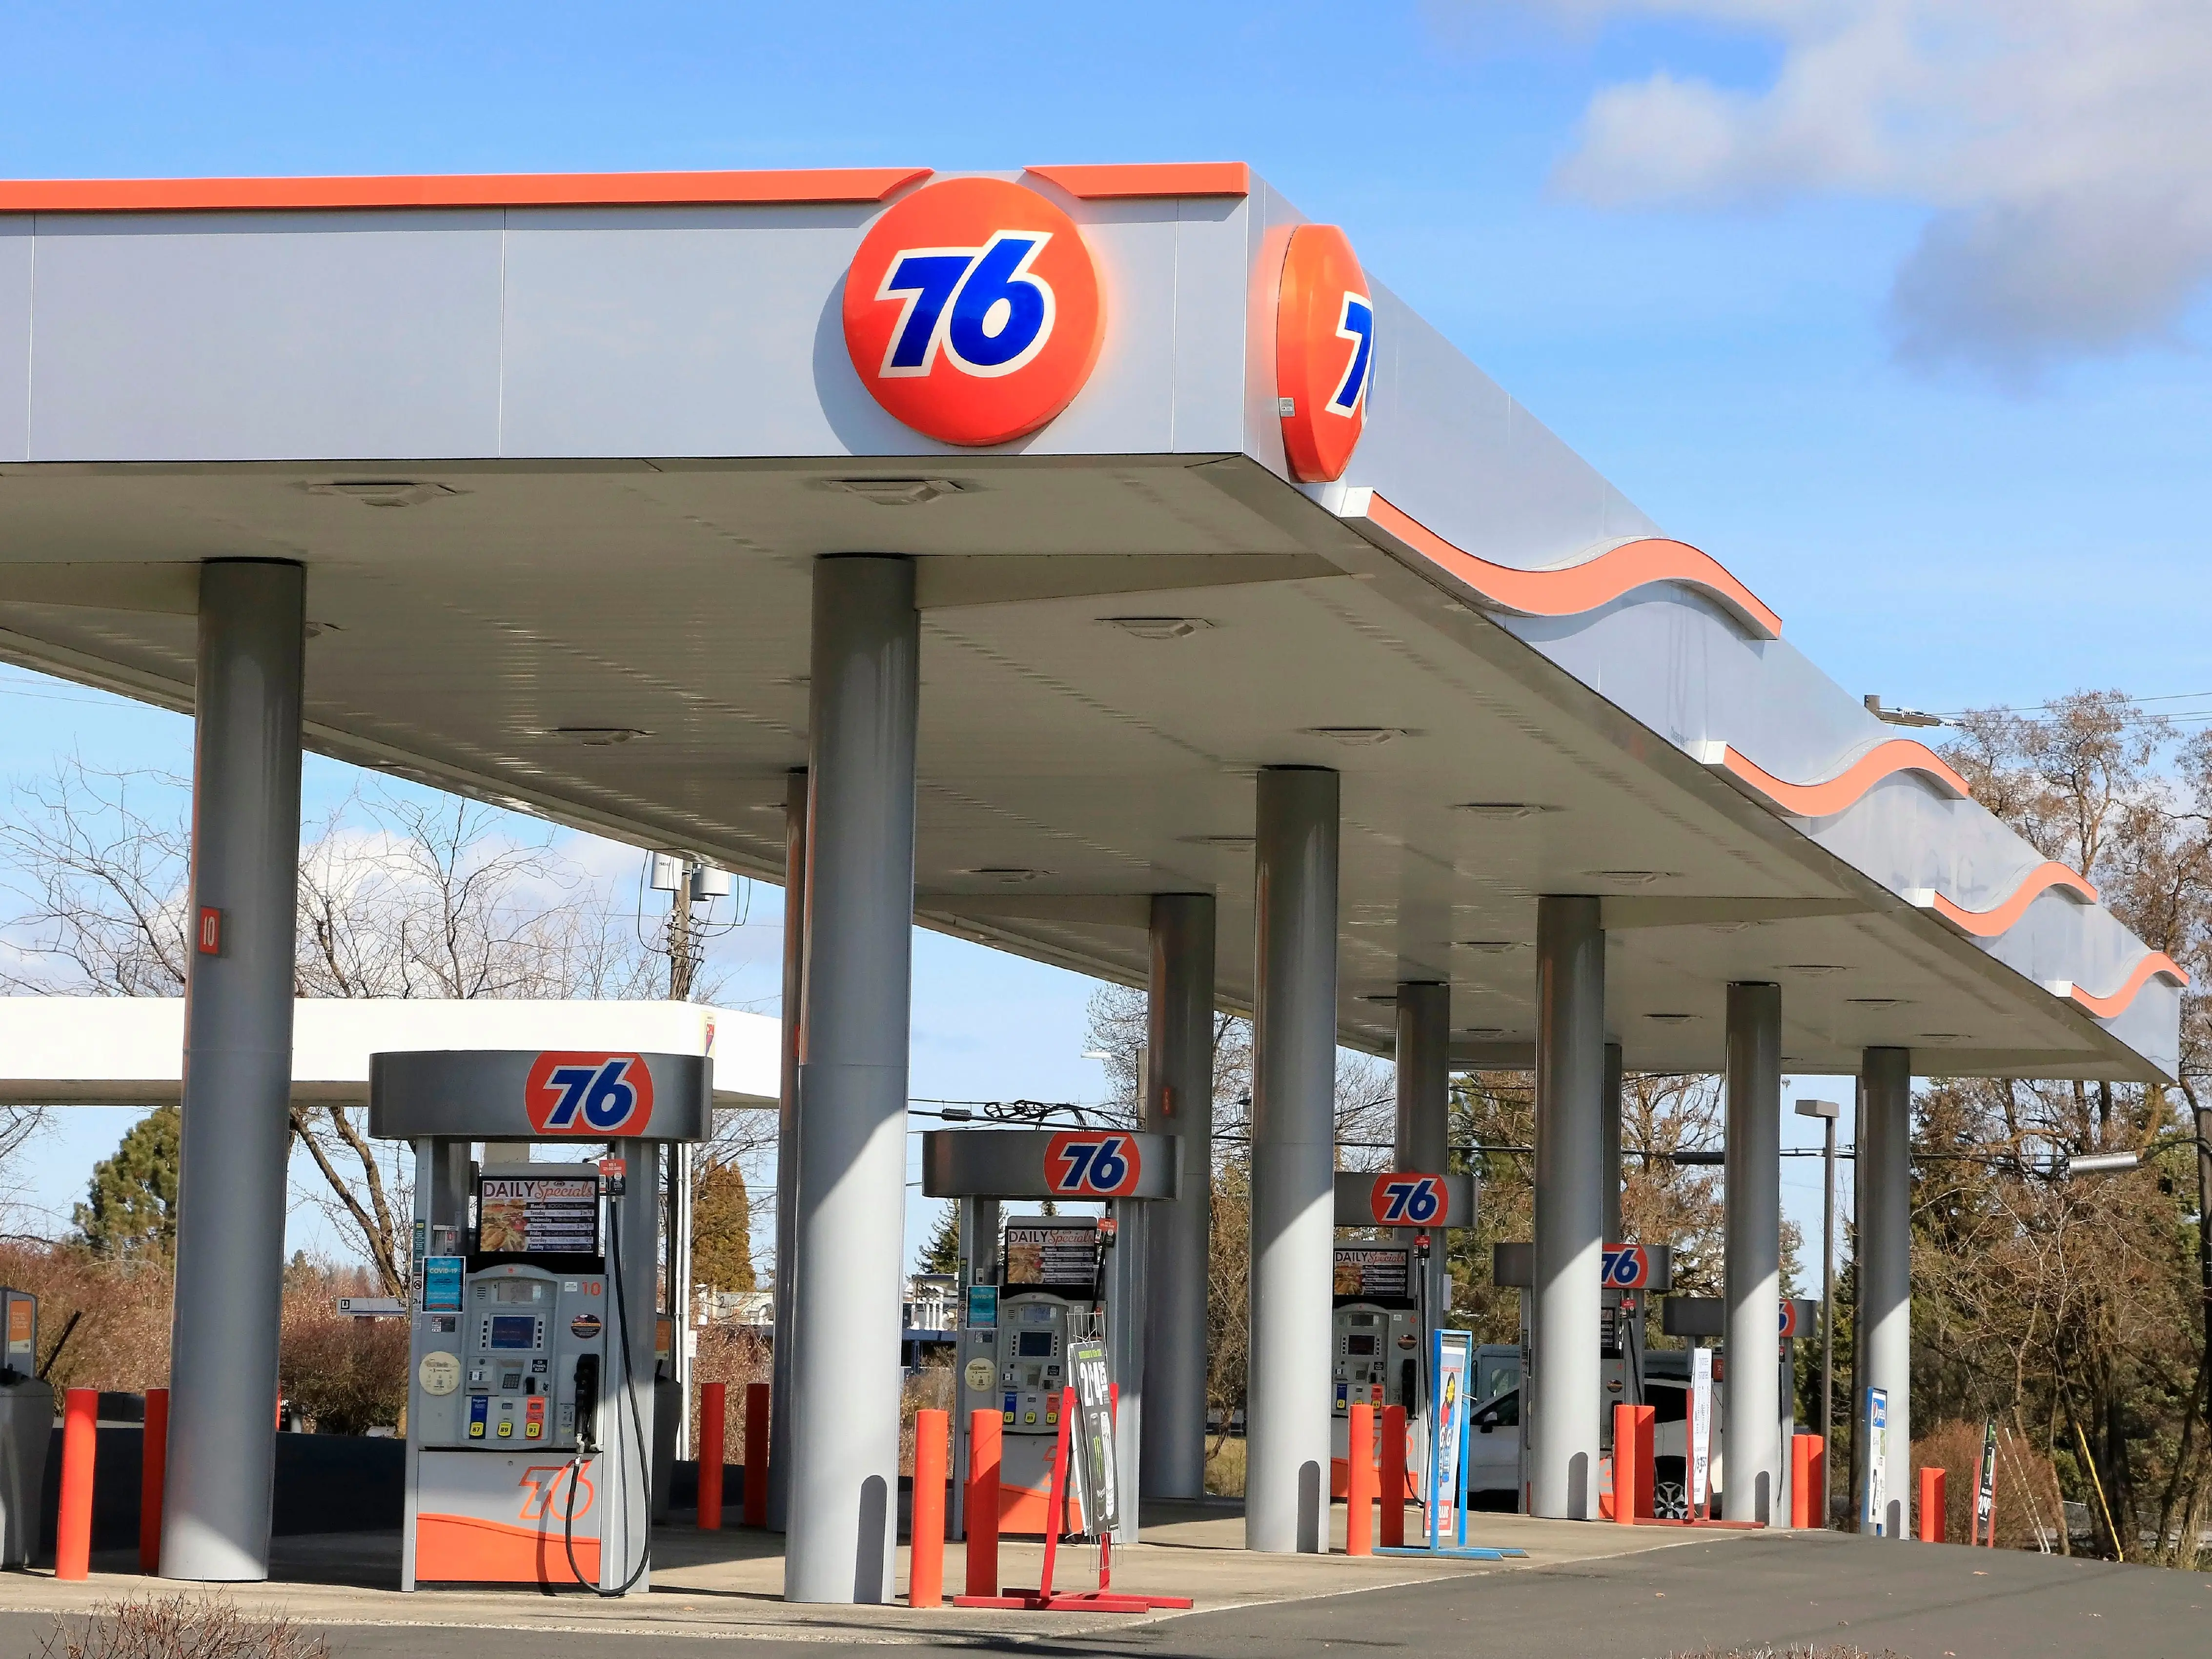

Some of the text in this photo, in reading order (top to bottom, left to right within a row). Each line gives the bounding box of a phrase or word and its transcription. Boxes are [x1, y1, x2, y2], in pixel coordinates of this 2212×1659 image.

[874, 230, 1056, 379] 76
[1324, 291, 1376, 425] 7
[203, 916, 215, 947] 10
[542, 1057, 637, 1132] 76
[1057, 1136, 1129, 1193] 76
[483, 1180, 594, 1205] DAILY Specials
[1381, 1178, 1440, 1224] 76
[1009, 1230, 1094, 1246] DAILY Specials
[1335, 1252, 1404, 1265] DAILY Specials
[582, 1281, 601, 1296] 10
